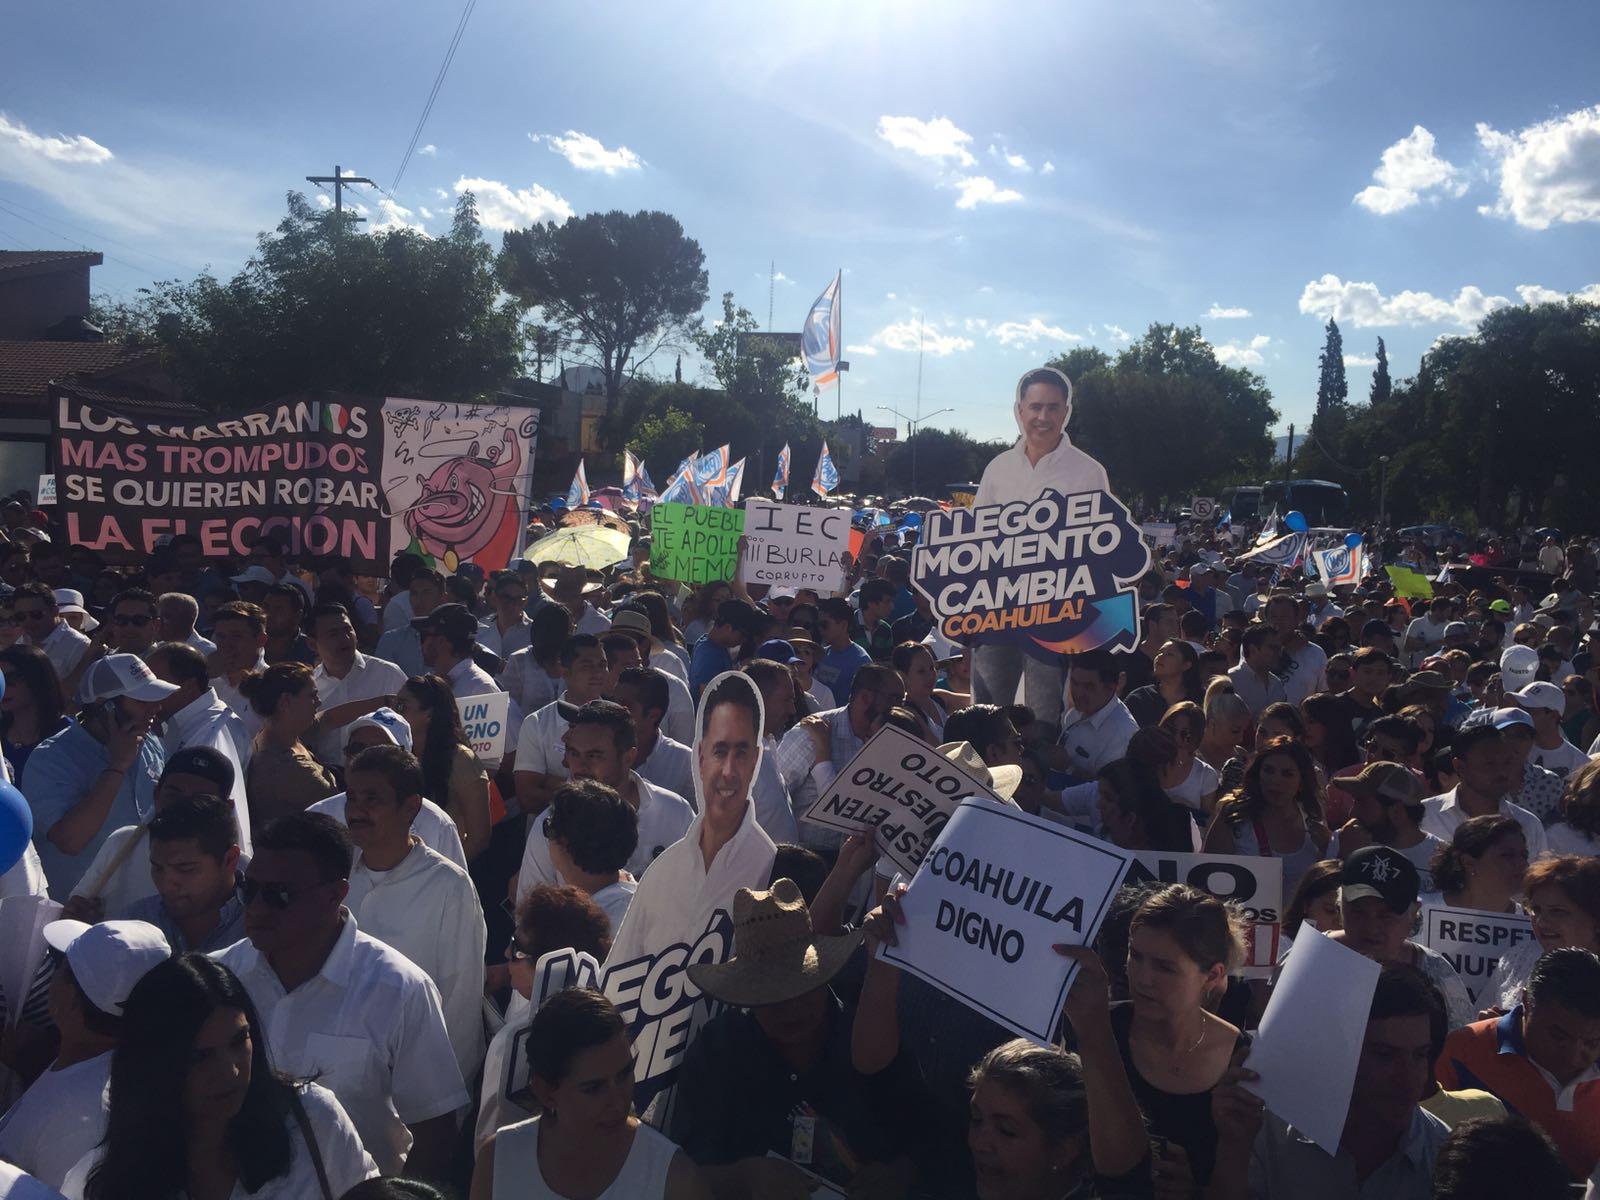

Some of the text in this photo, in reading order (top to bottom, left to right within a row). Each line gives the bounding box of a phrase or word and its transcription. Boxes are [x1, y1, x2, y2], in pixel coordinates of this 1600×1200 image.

[59, 397, 140, 435] LOS
[61, 438, 368, 474] MAS TROMPUDOS
[65, 474, 105, 503] SE
[113, 479, 265, 507] QUIEREN
[274, 477, 378, 509] ROBAR
[67, 512, 135, 550] LA
[653, 504, 743, 533] EL PUEBL
[930, 491, 1114, 545] LLEGÓ EL
[652, 527, 738, 556] TE APOLL
[916, 523, 1121, 579] MOMENTO
[674, 556, 738, 584] MEMO
[755, 570, 824, 582] CORRUPTO
[938, 564, 1096, 616] CAMBIA
[944, 599, 1085, 637] COAHUILA!
[463, 703, 488, 720] UN
[472, 741, 491, 752] OTO
[852, 767, 950, 826] UESTRO
[823, 793, 925, 867] ESPETEN
[935, 899, 1025, 963] DIGNO
